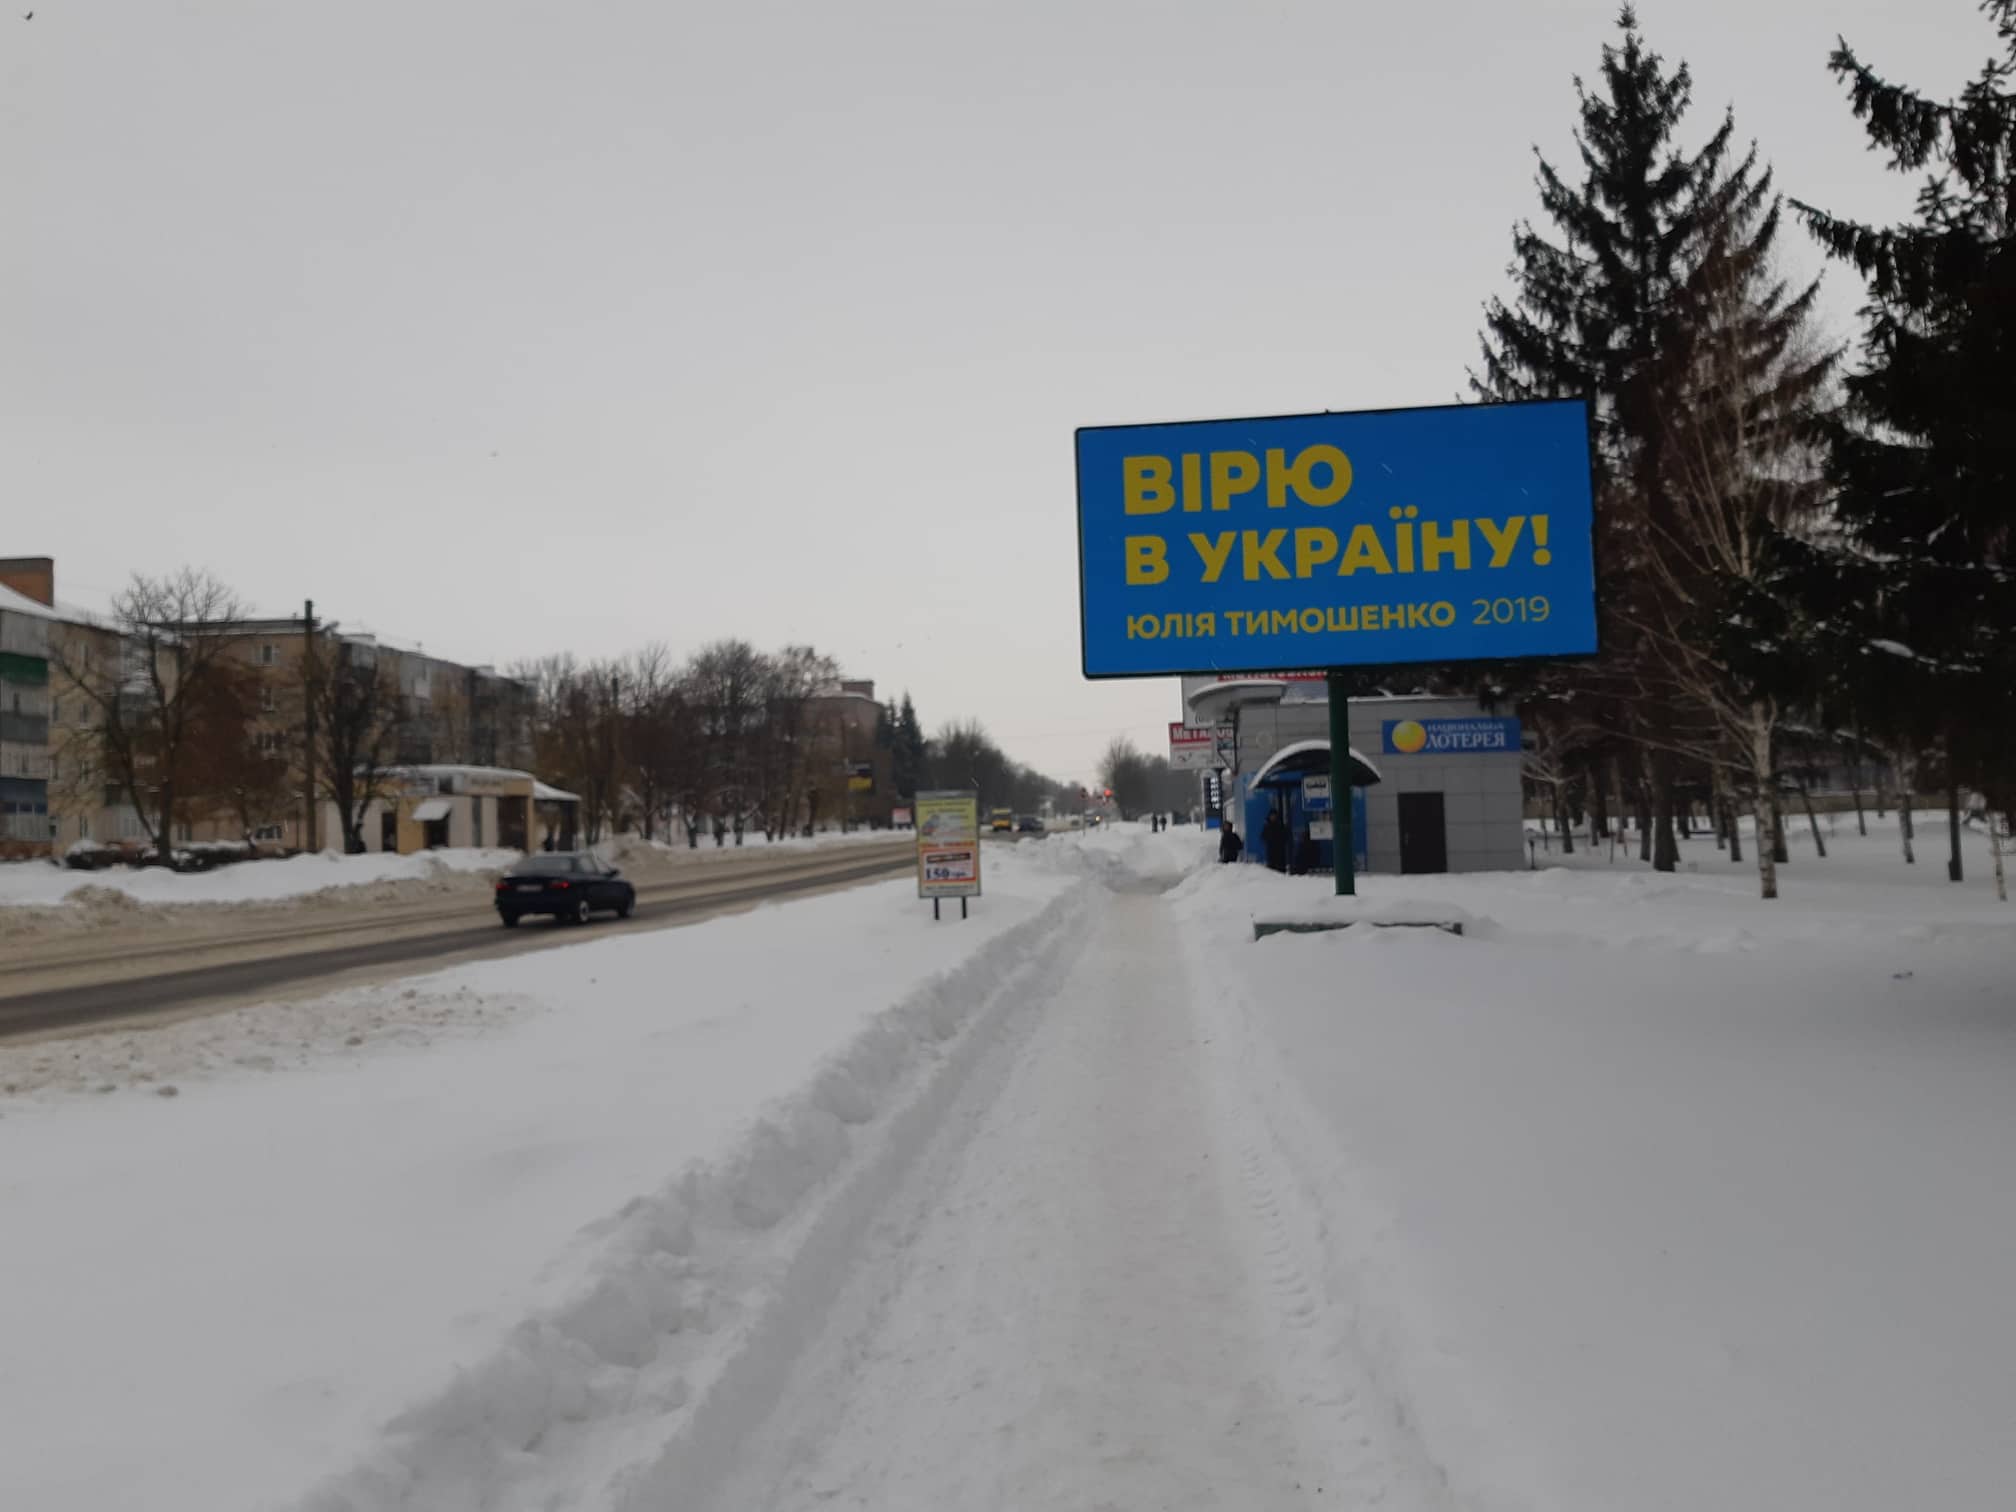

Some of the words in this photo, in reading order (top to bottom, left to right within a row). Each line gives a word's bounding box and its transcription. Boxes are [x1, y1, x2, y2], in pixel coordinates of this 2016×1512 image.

[1123, 444, 1353, 515] ВІРЮ
[1124, 535, 1171, 585] В
[1188, 505, 1552, 583] УКРАЇНУ!
[1127, 611, 1217, 639] ЮЛІЯ
[1224, 601, 1457, 635] ТИМОШЕНКО
[1473, 595, 1551, 626] 2019
[1426, 731, 1506, 750] ЛОТЕРЕЯ
